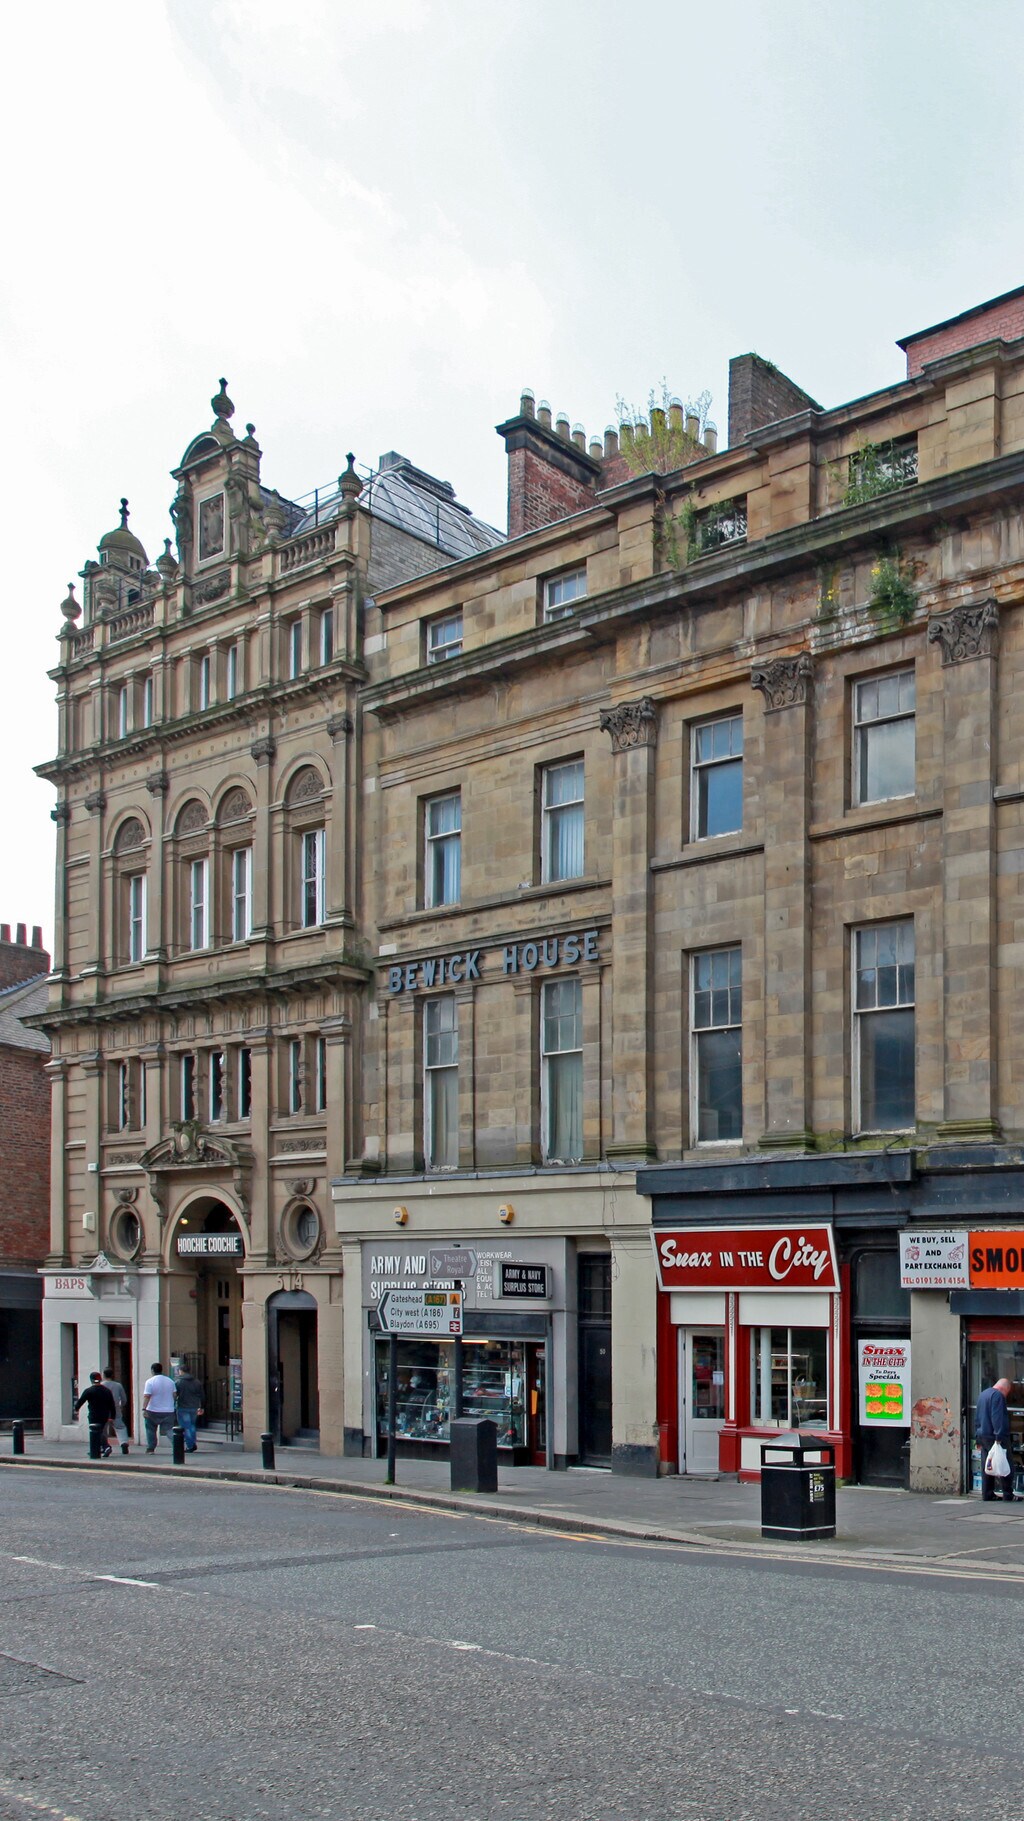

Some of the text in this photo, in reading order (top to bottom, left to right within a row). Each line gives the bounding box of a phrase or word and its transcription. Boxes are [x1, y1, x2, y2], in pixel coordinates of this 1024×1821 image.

[389, 931, 600, 993] BEWICK HOUSE
[178, 1236, 239, 1253] HOOCHIE COOCHIE
[922, 1236, 939, 1244] BUY,
[443, 1254, 467, 1263] Theatre
[477, 1251, 512, 1259] WORKWEAR
[660, 1236, 831, 1280] Snax IN THE City
[371, 1256, 426, 1274] ARMY AND
[446, 1266, 465, 1275] Royal
[505, 1268, 542, 1280] ARMY & NAVY
[55, 1277, 85, 1290] BAPS
[504, 1281, 527, 1292] SURPLUS
[528, 1282, 545, 1294] STORE
[390, 1294, 423, 1303] Gateshead
[390, 1308, 403, 1317] City
[405, 1309, 420, 1317] west
[390, 1320, 414, 1330] Blaydon
[862, 1343, 906, 1356] Snax
[862, 1357, 907, 1367] IN THE CITY
[814, 1484, 825, 1492] £75
